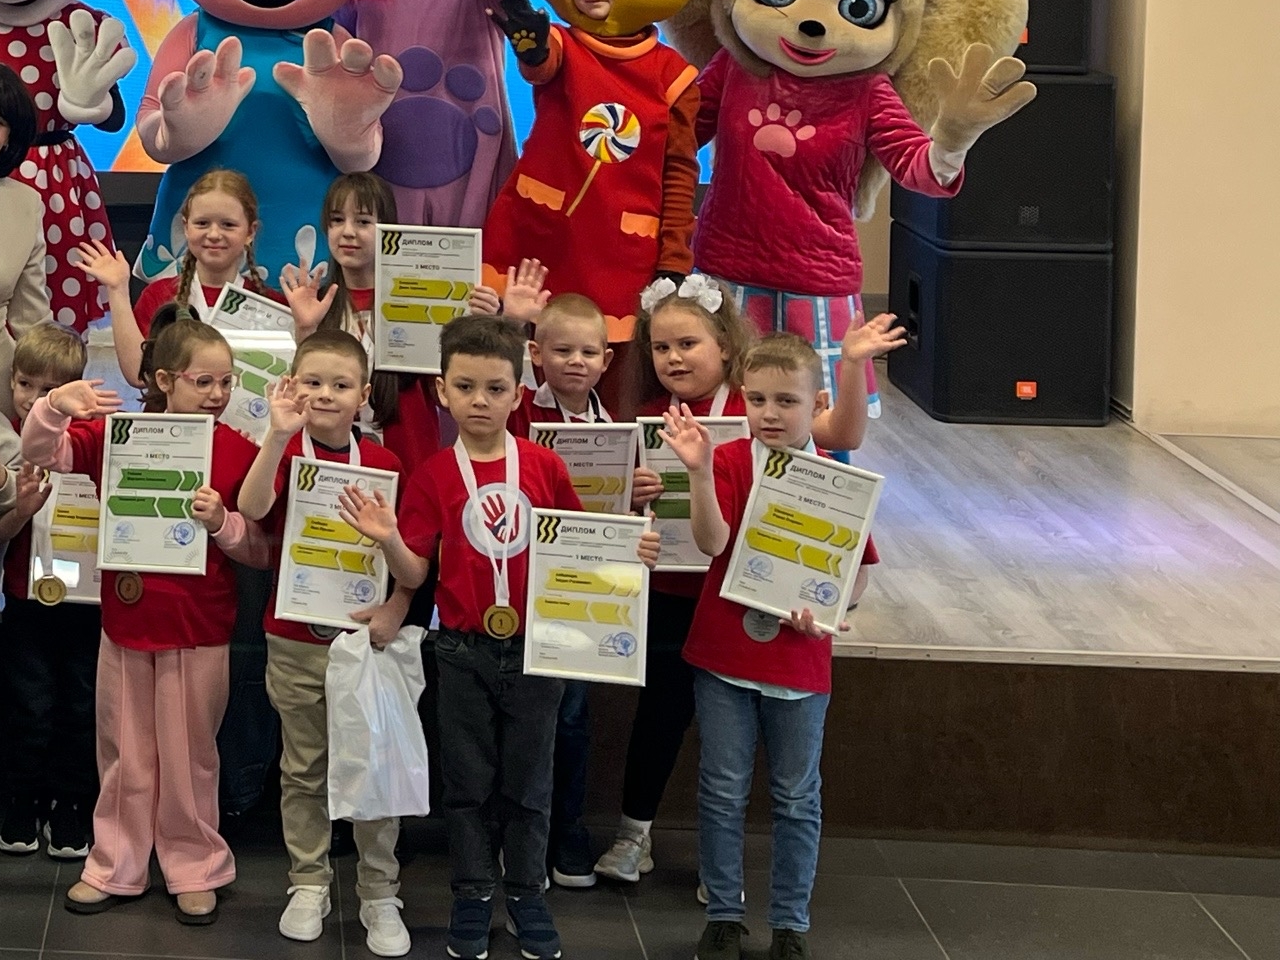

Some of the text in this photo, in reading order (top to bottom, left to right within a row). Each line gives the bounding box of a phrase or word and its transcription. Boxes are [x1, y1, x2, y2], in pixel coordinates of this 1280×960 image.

[132, 426, 164, 434] ДИПЛОМ
[556, 437, 588, 445] ДИПЛОМ
[789, 464, 826, 481] ДИПЛОМ
[318, 475, 350, 485] ДИПЛОМ
[560, 525, 596, 534] ДИПЛОМ
